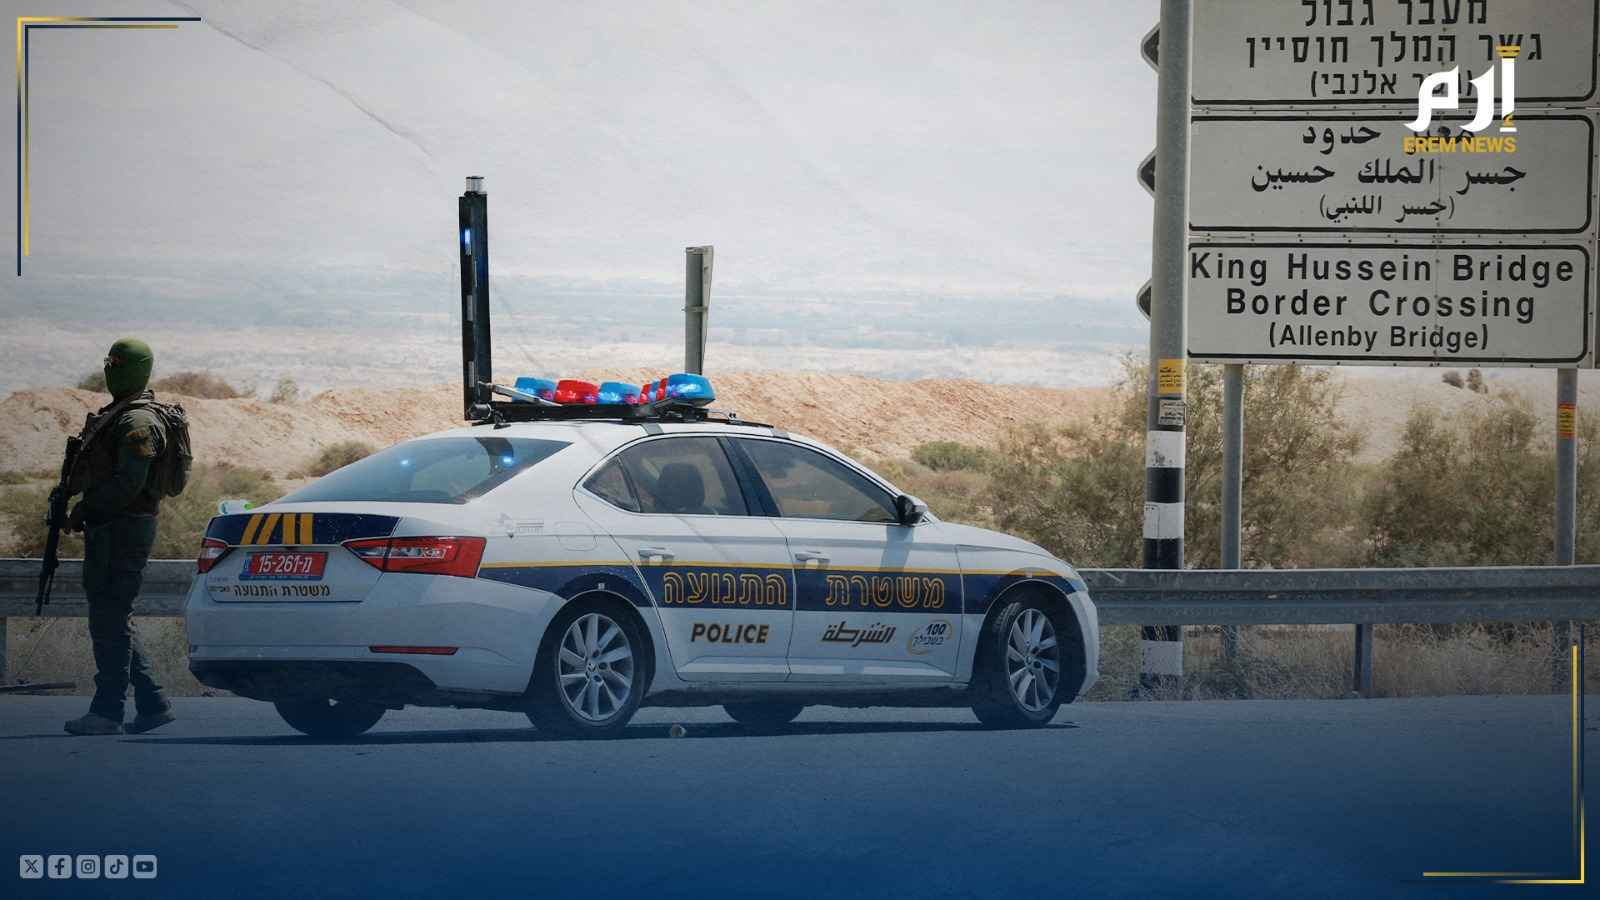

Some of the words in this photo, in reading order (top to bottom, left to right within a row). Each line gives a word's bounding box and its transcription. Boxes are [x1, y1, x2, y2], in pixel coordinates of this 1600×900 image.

[1302, 0, 1375, 27] גבול
[1398, 0, 1487, 25] מעבר
[1246, 36, 1348, 68] חוסיין
[1370, 30, 1456, 68] המלך
[1310, 68, 1397, 97] אלנבי)
[1302, 126, 1382, 154] حدود
[1251, 163, 1336, 192] حسين
[1357, 158, 1435, 185] الملك
[1456, 167, 1527, 195] جسر
[1191, 252, 1267, 287] King
[1287, 253, 1431, 282] Hussein
[1453, 254, 1574, 289] Bridge
[1226, 287, 1347, 317] Border
[1369, 289, 1535, 324] Crossing
[1269, 322, 1377, 352] (Allenby
[1390, 324, 1488, 353] Bridge)
[233, 584, 278, 597] התנועה
[281, 584, 331, 597] משטרת
[663, 571, 788, 605] התנועה
[825, 574, 945, 609] משטרת
[690, 623, 769, 644] POLICE
[821, 621, 897, 648] الشرطة
[926, 623, 948, 635] 100
